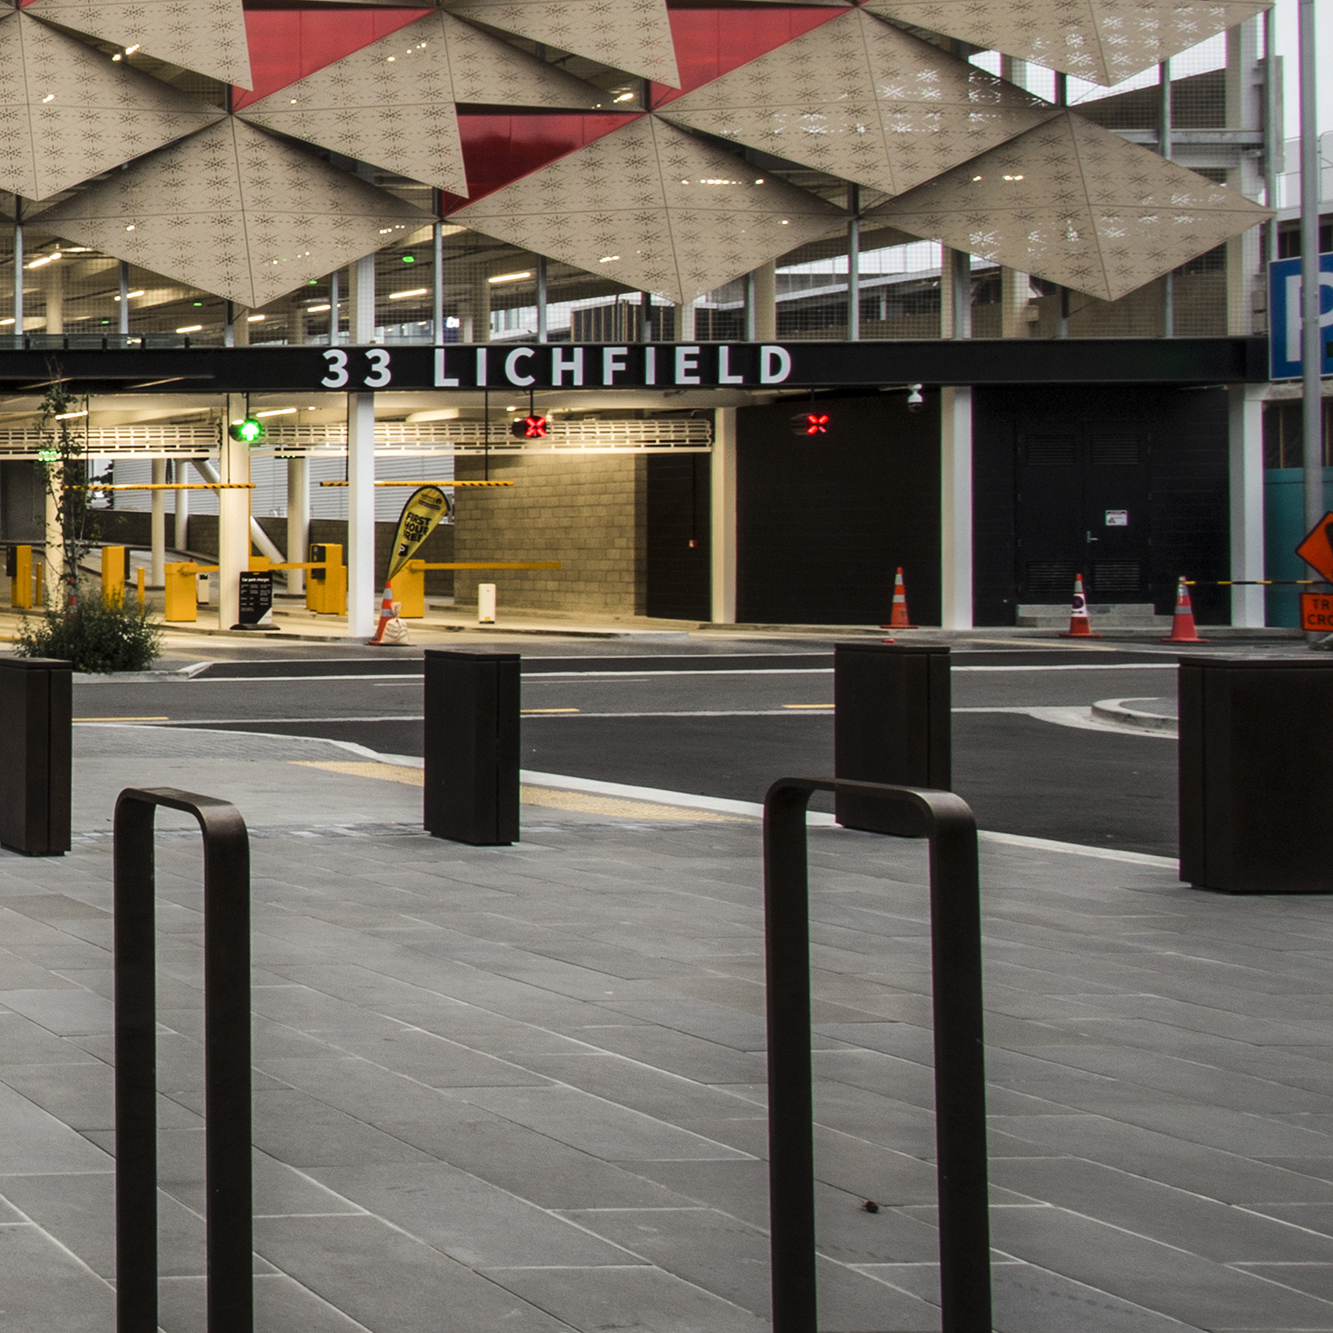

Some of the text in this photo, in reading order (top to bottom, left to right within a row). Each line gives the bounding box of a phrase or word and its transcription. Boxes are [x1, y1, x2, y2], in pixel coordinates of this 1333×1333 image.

[321, 345, 792, 388] 33 LICHFIELD
[406, 512, 432, 526] FIRST
